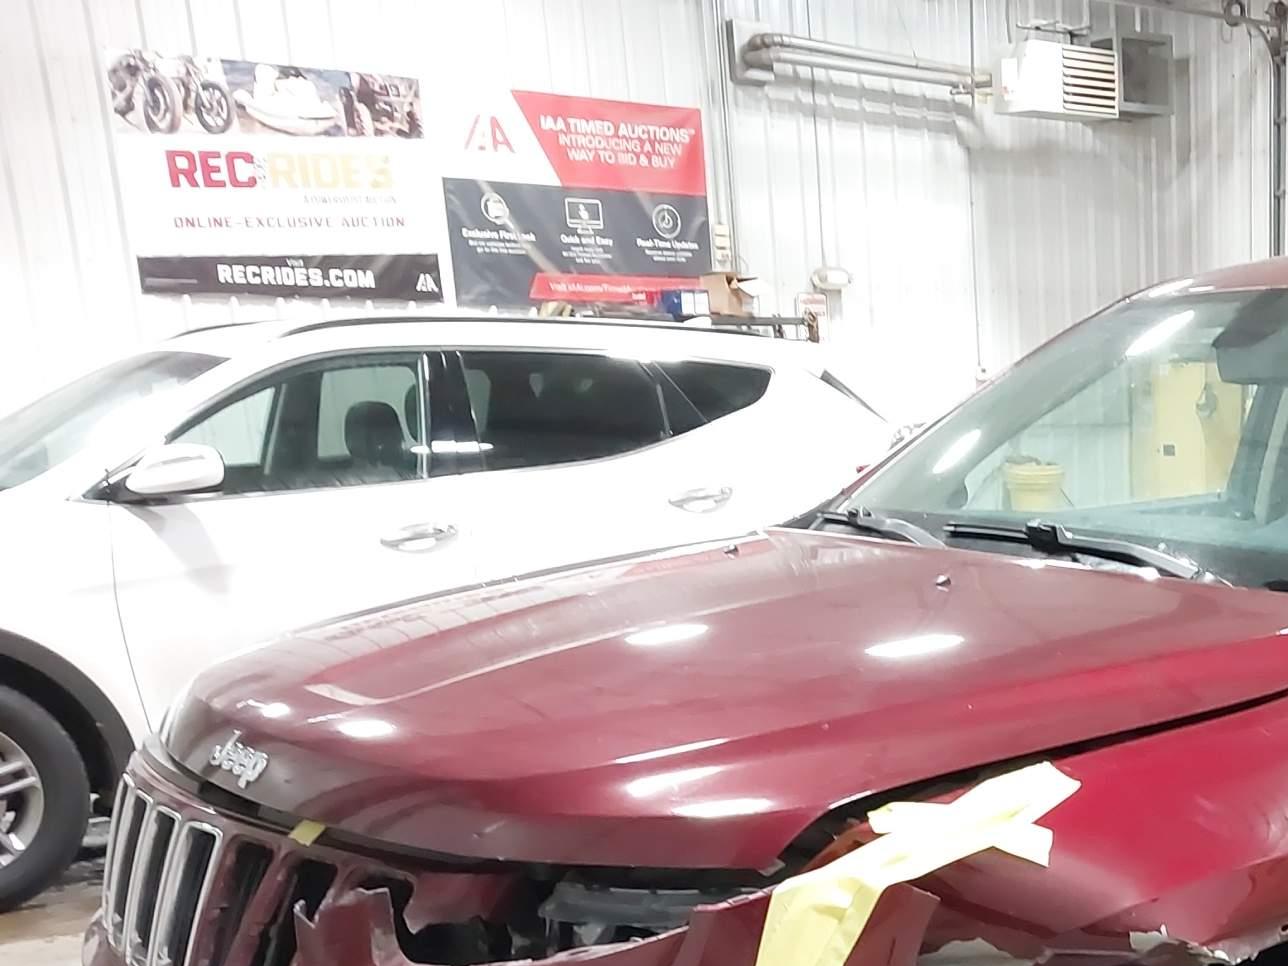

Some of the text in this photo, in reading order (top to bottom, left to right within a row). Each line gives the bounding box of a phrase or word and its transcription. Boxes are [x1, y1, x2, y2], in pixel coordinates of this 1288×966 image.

[539, 115, 566, 132] IAA
[566, 117, 615, 136] TIMED
[558, 133, 683, 156] INTRODUCING A NEW
[567, 149, 676, 168] WAY TO BID & BUY
[341, 215, 405, 228] AUCTION
[216, 263, 375, 289] RECRIDES.COM
[209, 729, 269, 789] Jeep
